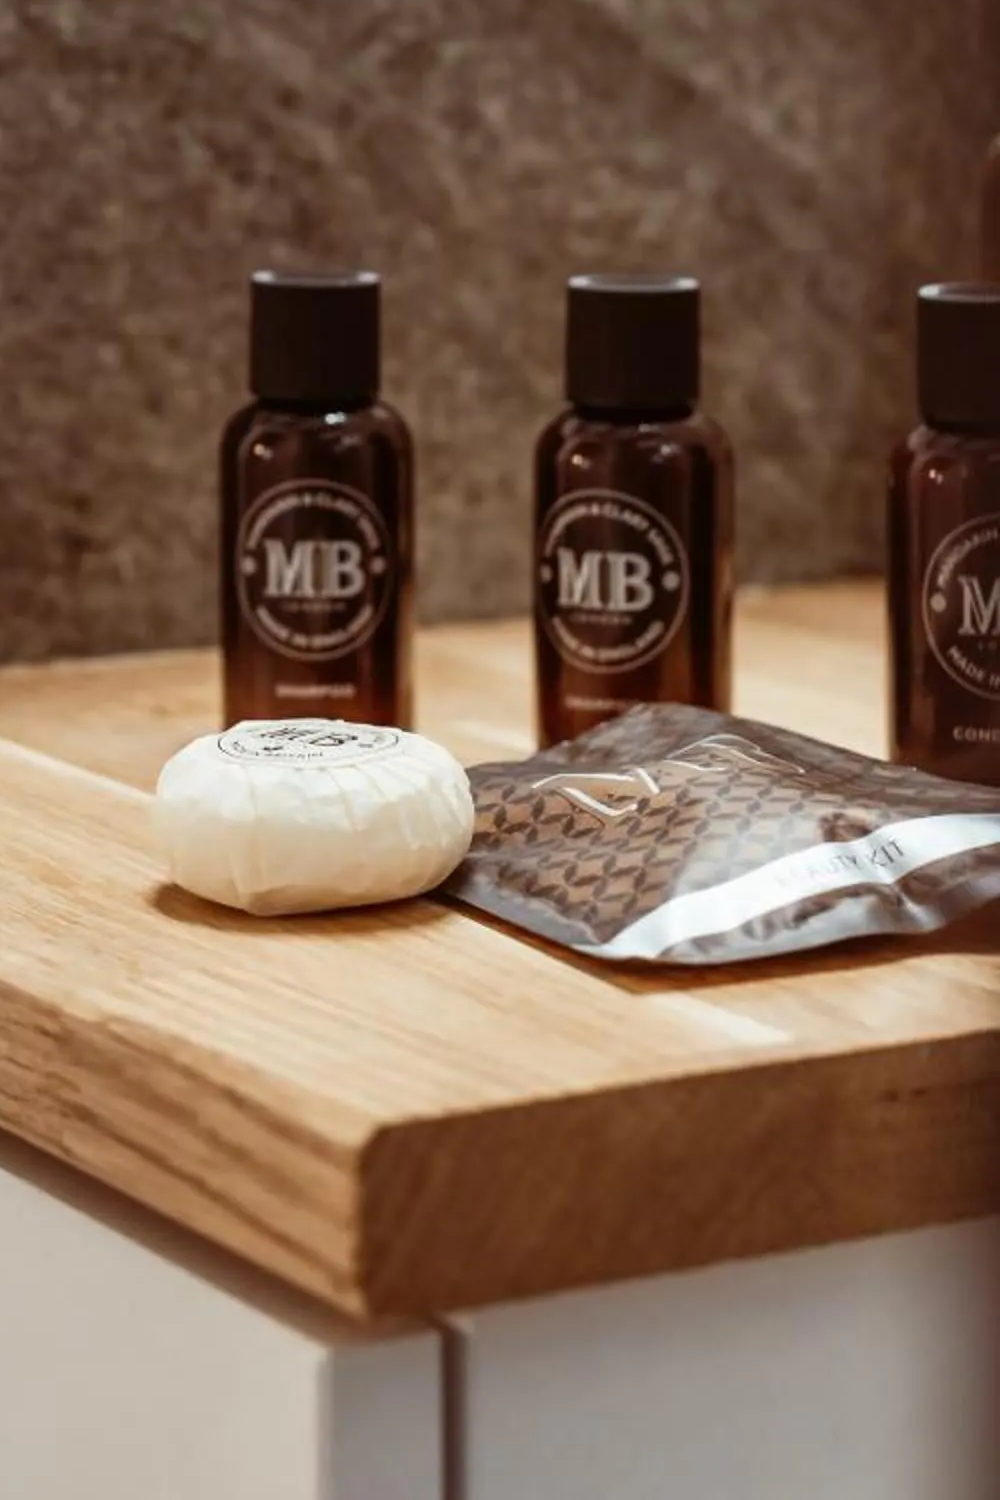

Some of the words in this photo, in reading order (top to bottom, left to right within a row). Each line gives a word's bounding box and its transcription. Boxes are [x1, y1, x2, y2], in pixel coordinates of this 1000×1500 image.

[263, 538, 366, 598] MB
[556, 547, 655, 612] MB
[868, 838, 906, 868] KIT
